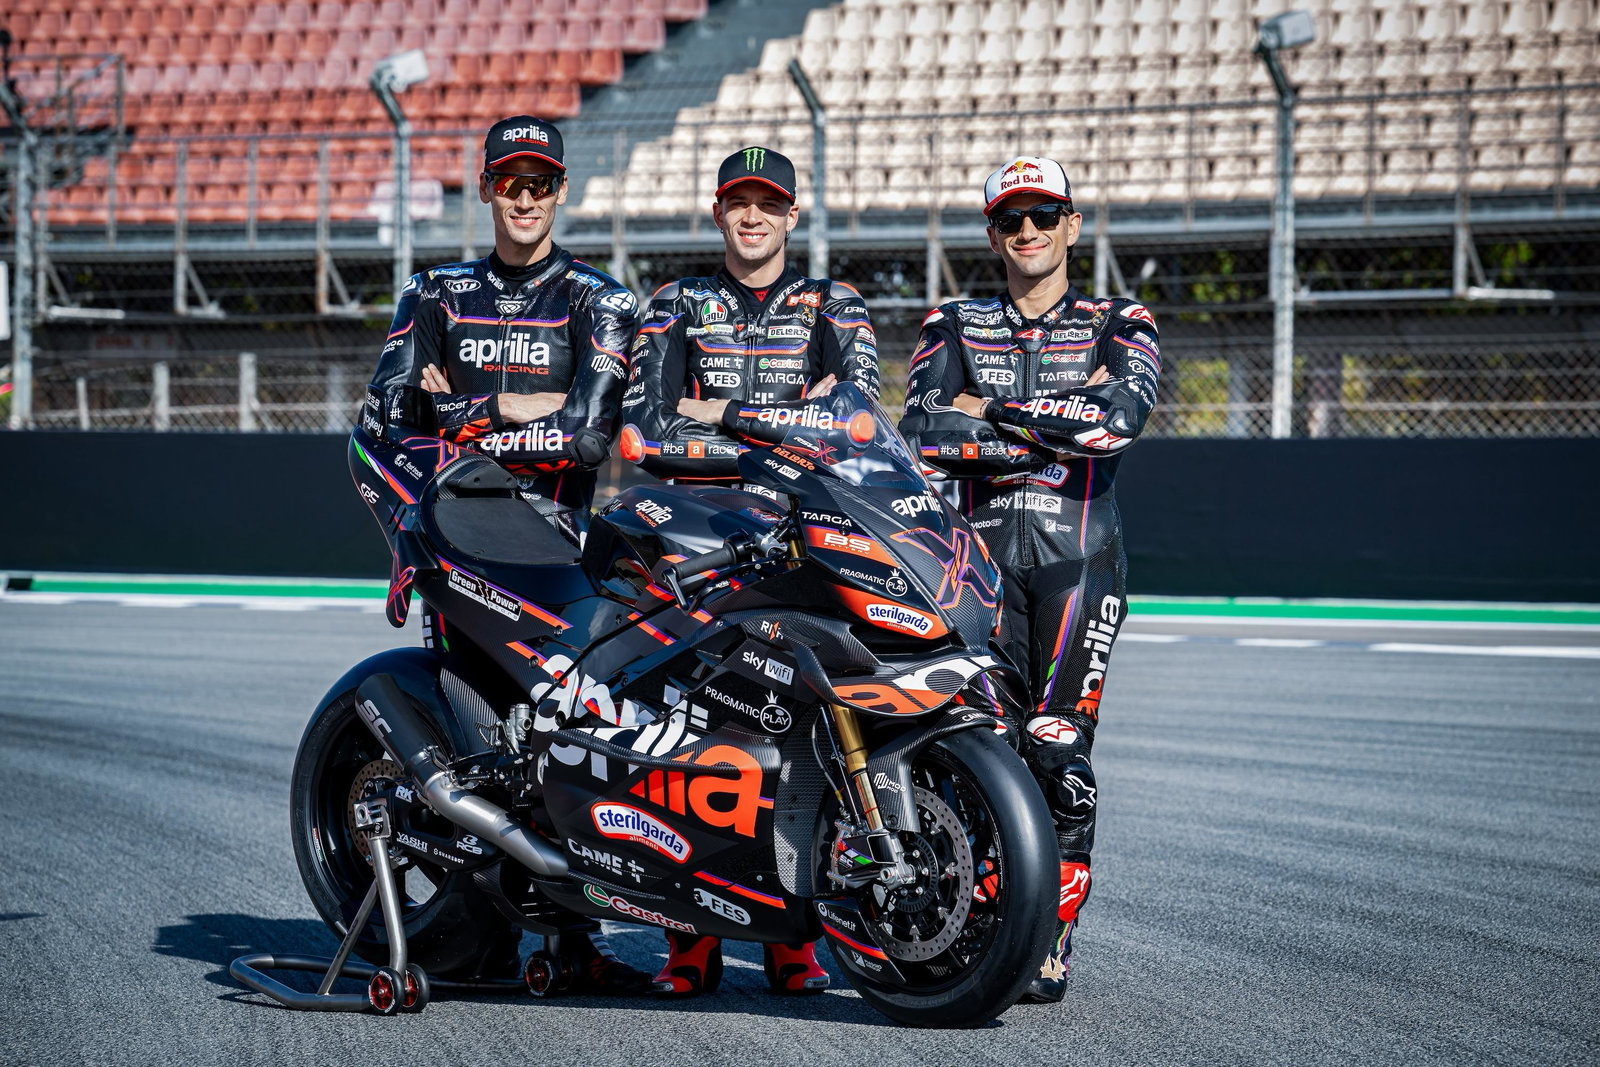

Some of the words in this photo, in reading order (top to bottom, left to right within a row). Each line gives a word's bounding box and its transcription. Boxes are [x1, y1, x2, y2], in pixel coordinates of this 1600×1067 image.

[503, 125, 548, 142] aprilia
[1001, 176, 1019, 190] Red
[1023, 175, 1043, 183] Bull
[719, 288, 738, 311] aprilia
[769, 279, 805, 314] DAINESE
[459, 332, 550, 369] aprilia
[975, 354, 1006, 365] CAME
[483, 364, 549, 375] RACING
[701, 358, 730, 367] CAME
[770, 360, 803, 369] Castrol
[758, 373, 805, 384] TARGA
[1039, 371, 1088, 382] TARGA
[436, 401, 468, 411] racer
[1020, 395, 1100, 423] aprilia
[758, 404, 833, 430] aprilia
[480, 422, 563, 457] aprilia
[663, 443, 684, 454] #be
[692, 445, 700, 454] a
[708, 444, 738, 455] racer
[940, 445, 959, 455] #be
[967, 447, 974, 455] a
[981, 447, 1006, 455] racer
[764, 459, 781, 469] sky
[989, 495, 1012, 509] sky
[635, 500, 673, 524] aprilia
[802, 511, 852, 527] TARGA
[824, 533, 870, 551] BS
[840, 567, 885, 585] PRAGMATIC
[888, 581, 906, 592] PLAY
[452, 570, 477, 592] Green
[490, 589, 519, 612] Power
[870, 606, 928, 631] sterilgarda
[742, 651, 765, 670] sky
[768, 663, 791, 680] wifi
[705, 686, 760, 719] PRAGMATIC
[763, 712, 789, 725] PLAY
[395, 785, 413, 801] RK
[600, 809, 684, 854] sterilgarda
[397, 832, 428, 850] YASHI
[456, 841, 483, 855] RCB
[629, 835, 659, 850] alimenti
[568, 838, 622, 876] CAME
[610, 896, 697, 935] Castrol
[828, 910, 856, 931] Lifenet.it
